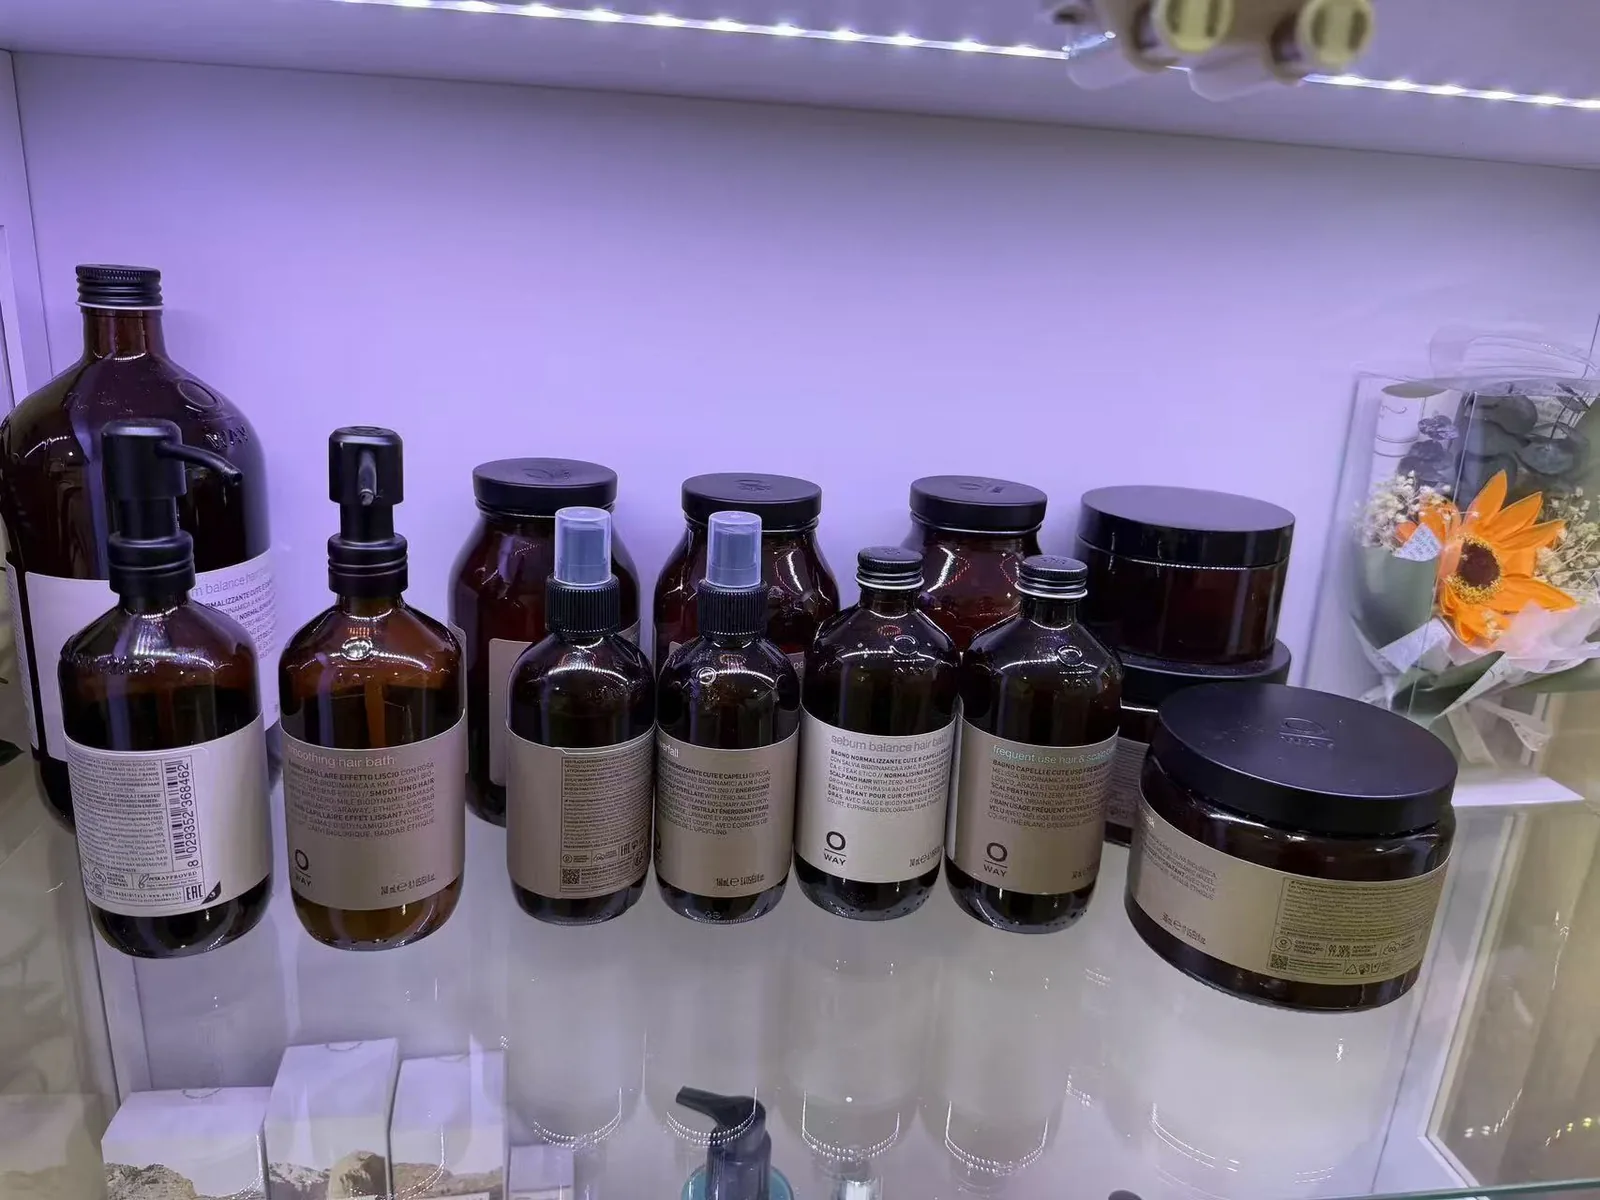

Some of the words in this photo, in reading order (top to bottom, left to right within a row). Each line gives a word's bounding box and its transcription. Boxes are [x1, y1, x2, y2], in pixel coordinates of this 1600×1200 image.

[205, 575, 244, 593] balance
[831, 735, 866, 749] sebum
[869, 742, 912, 751] balance
[914, 739, 931, 750] hair
[338, 757, 361, 768] hair
[366, 755, 395, 768] bath
[851, 755, 902, 763] NORMALIZZANTE
[993, 745, 1035, 763] frequent
[992, 760, 1014, 769] BAGNO
[303, 767, 337, 778] CAPILLARE
[374, 771, 399, 780] LISCIO
[178, 763, 192, 808] 368462
[369, 783, 416, 797] SMOOTHING
[418, 778, 434, 786] HAIR
[370, 811, 401, 820] LISSANT
[182, 810, 198, 854] 029352
[826, 831, 846, 850] O
[294, 848, 309, 870] O
[824, 853, 846, 866] WAY
[986, 842, 1008, 862] O
[188, 860, 198, 868] 8
[983, 864, 1006, 877] WAY
